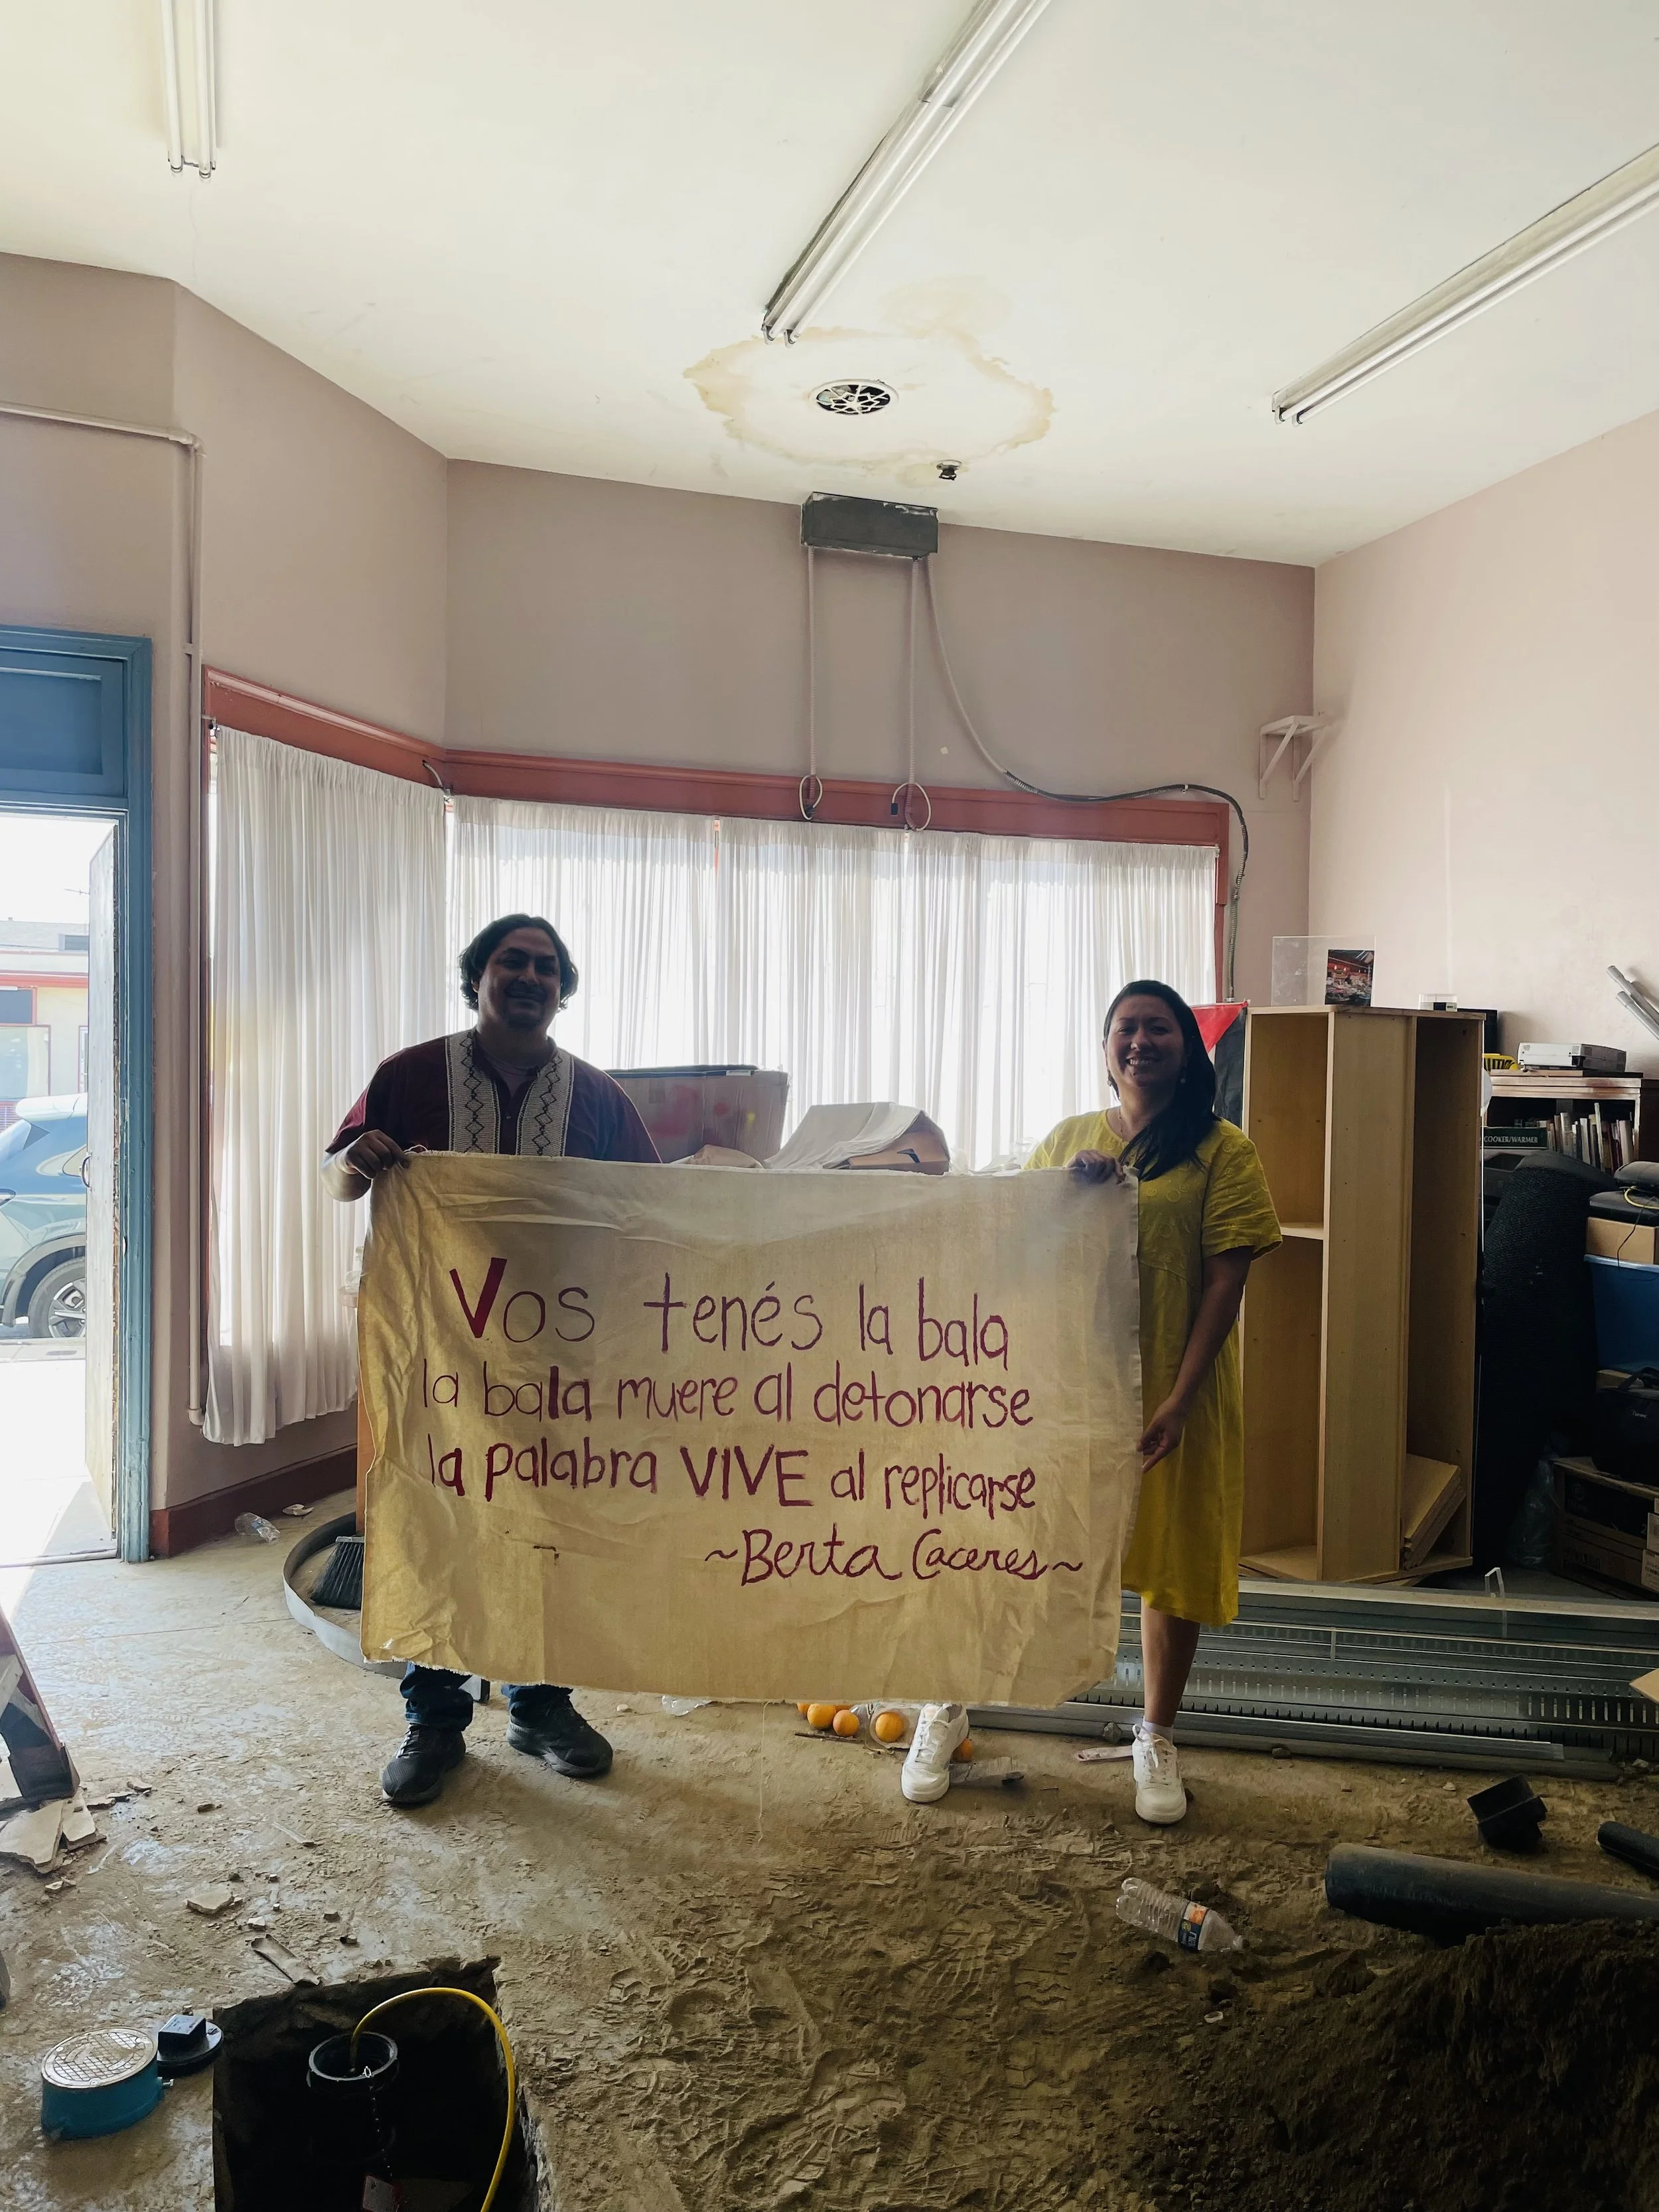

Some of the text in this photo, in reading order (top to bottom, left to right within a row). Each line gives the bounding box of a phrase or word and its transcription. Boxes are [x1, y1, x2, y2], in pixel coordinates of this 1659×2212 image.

[449, 1256, 1009, 1371] Vos tenés la bala
[423, 1358, 1034, 1429] la bala muere al detonarse
[427, 1434, 1037, 1521] la palabra VIVE al replicarse
